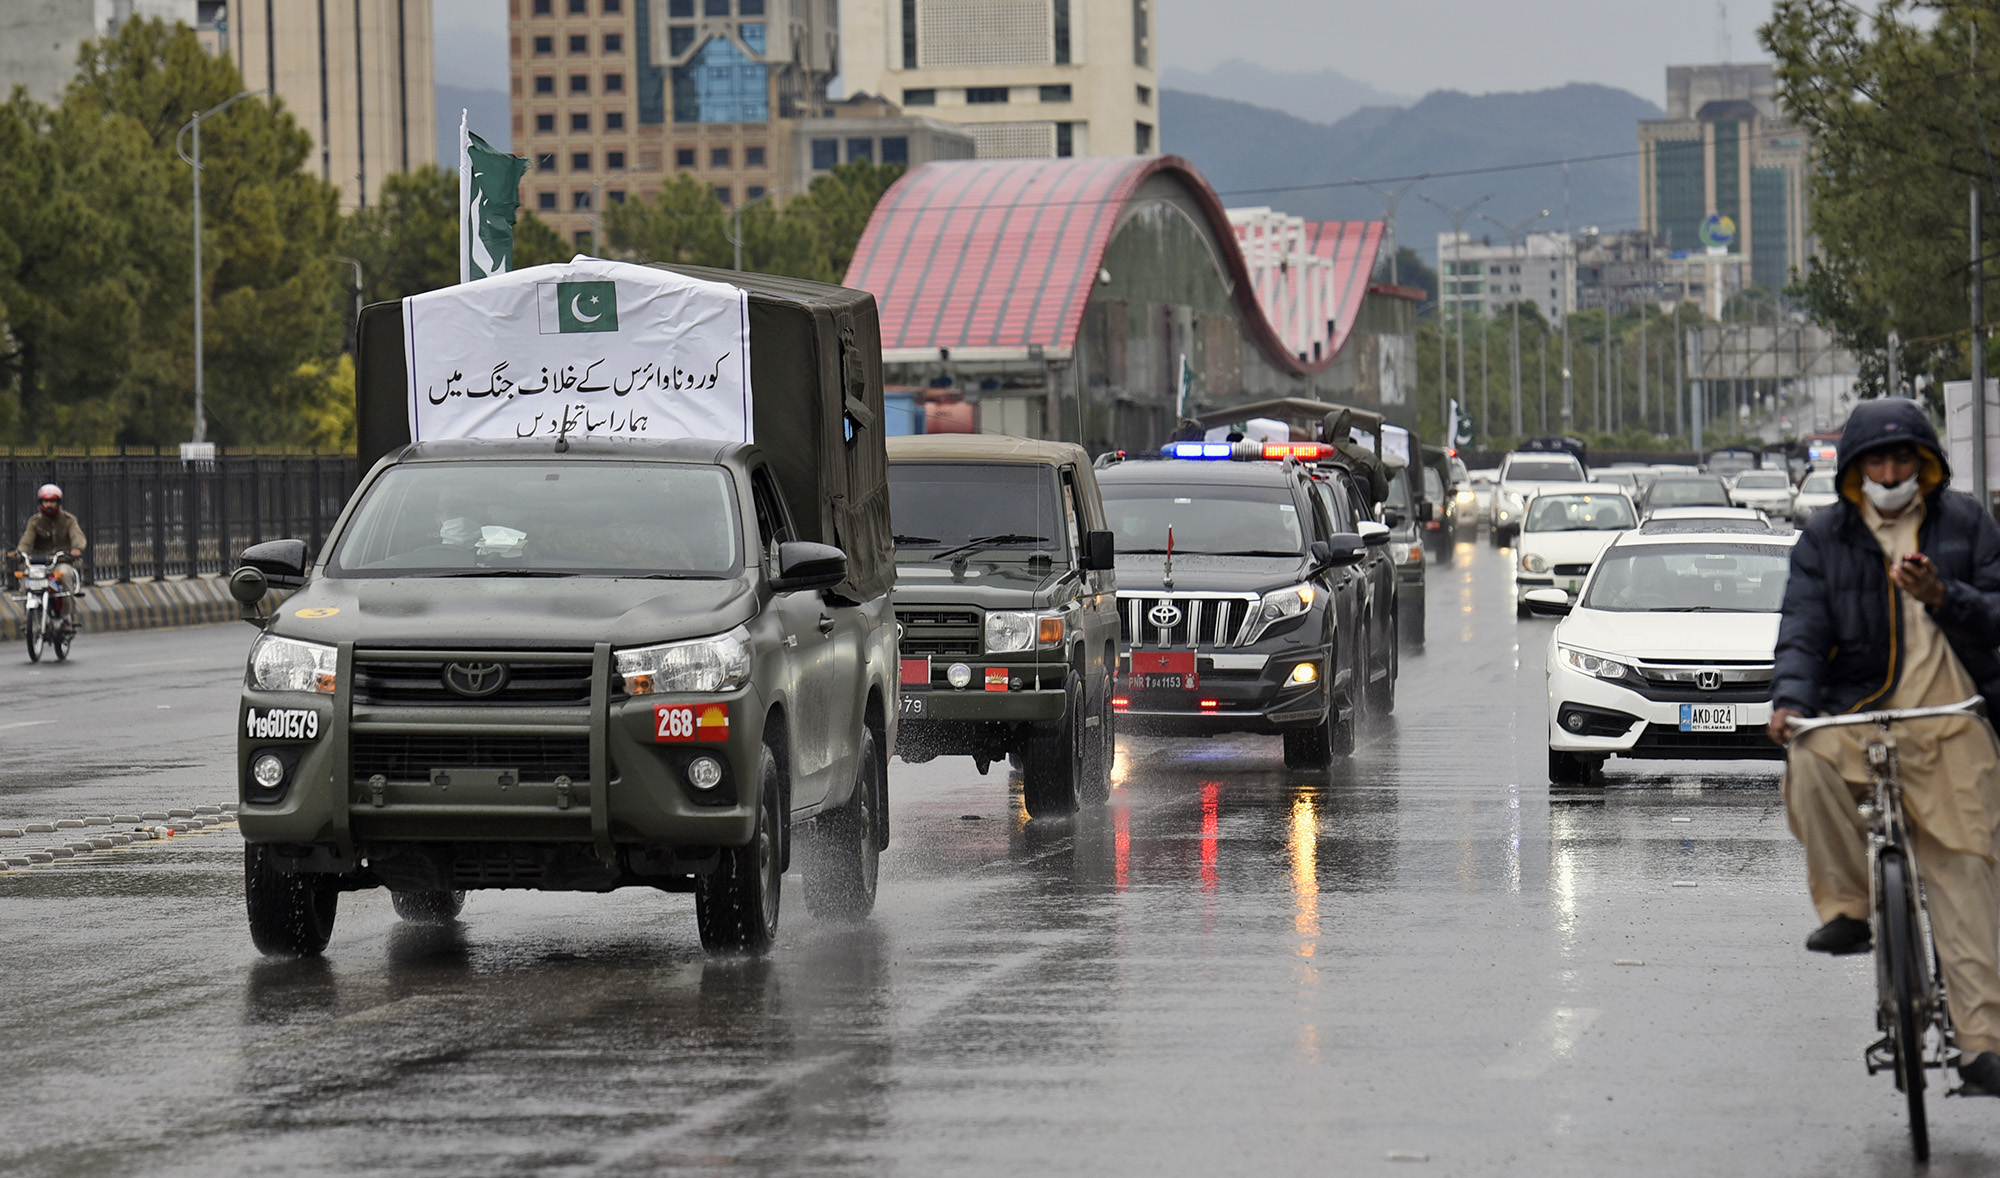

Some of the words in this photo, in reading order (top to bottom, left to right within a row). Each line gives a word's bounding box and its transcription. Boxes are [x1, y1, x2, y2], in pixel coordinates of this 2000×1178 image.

[428, 369, 463, 405] میں
[466, 360, 515, 400] جنگ
[518, 365, 578, 395] خلاف
[576, 357, 611, 393] کے
[609, 408, 649, 432] ہمارا
[1128, 677, 1145, 688] PNR
[658, 708, 693, 737] 268
